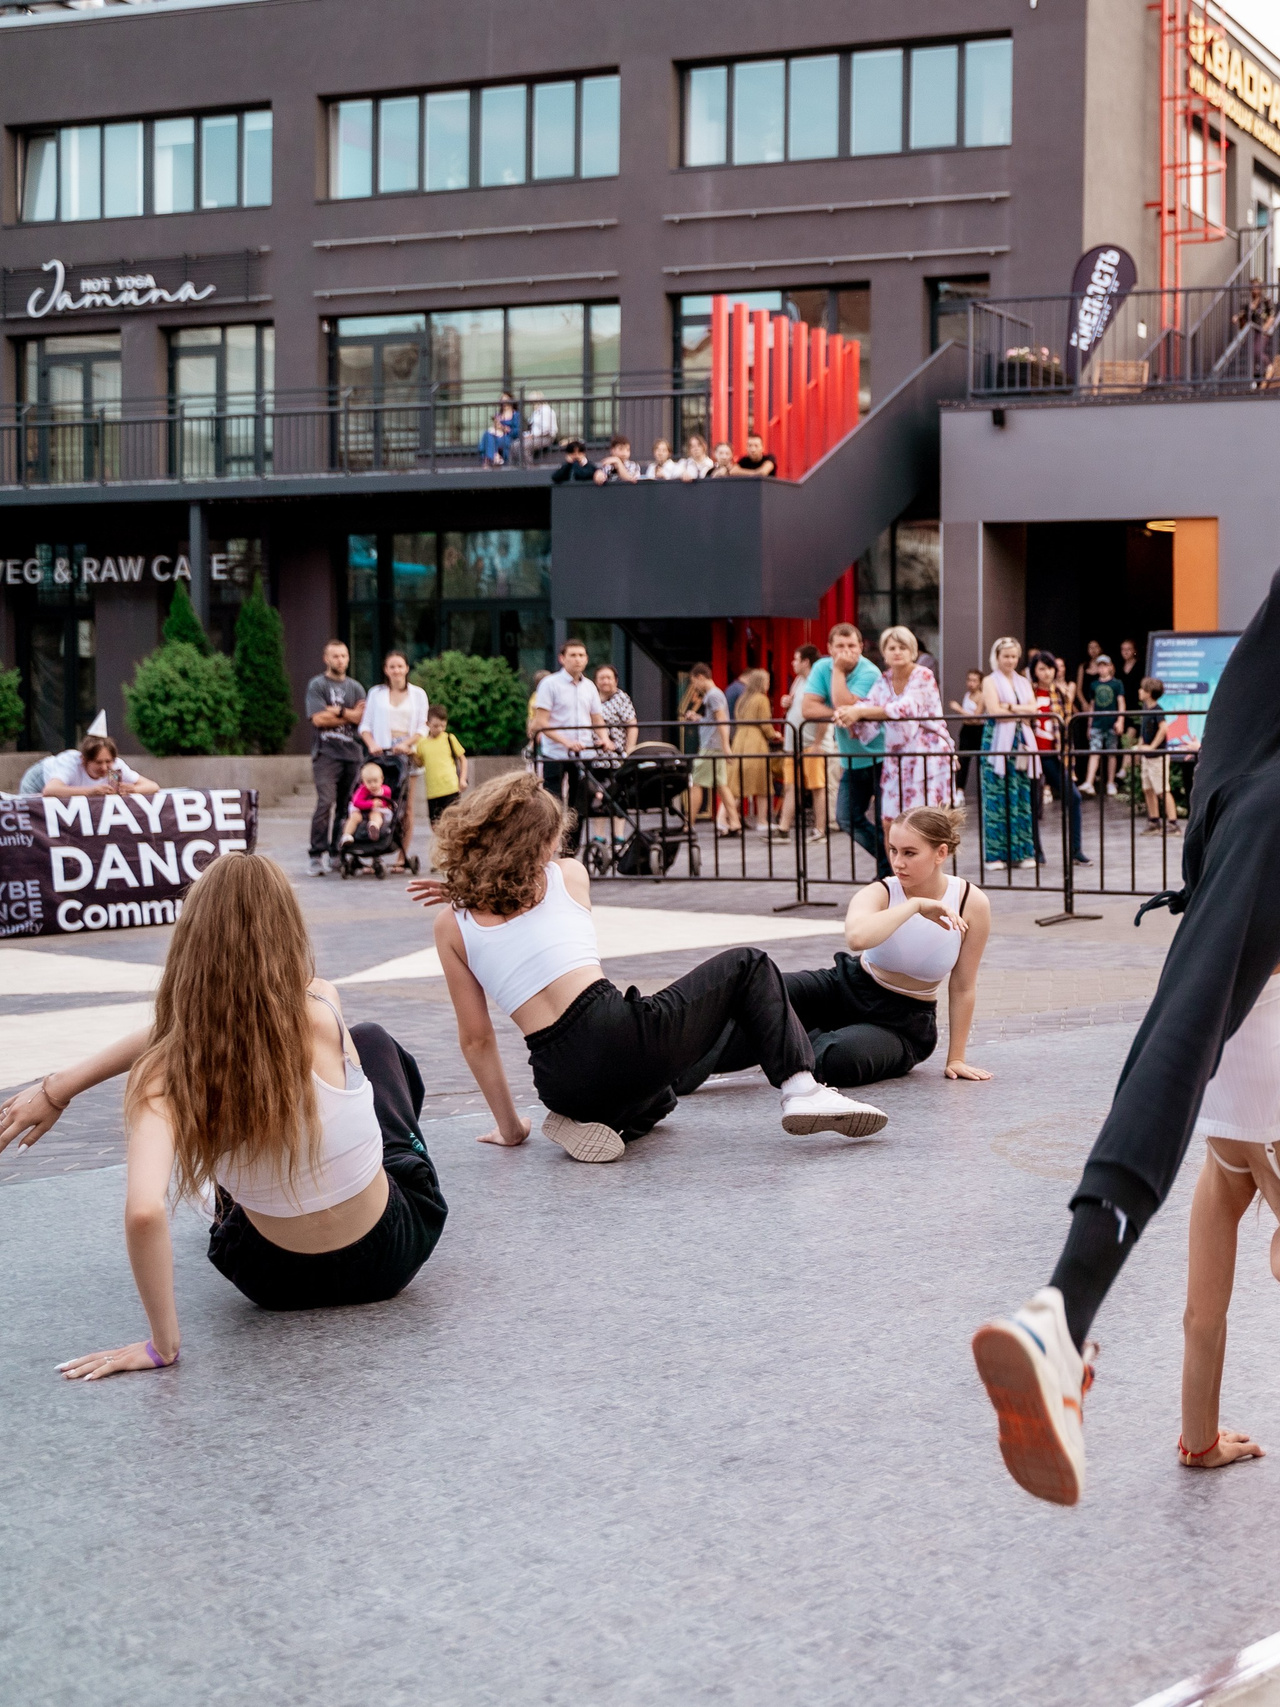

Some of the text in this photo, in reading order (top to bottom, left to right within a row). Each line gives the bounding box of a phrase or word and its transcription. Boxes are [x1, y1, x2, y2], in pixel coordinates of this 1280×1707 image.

[26, 258, 217, 318] Jamuna
[80, 273, 156, 293] HOT YOGA
[53, 557, 73, 584] &
[82, 555, 146, 583] RAW
[151, 553, 228, 581] CAE
[42, 789, 247, 838] MAYBE
